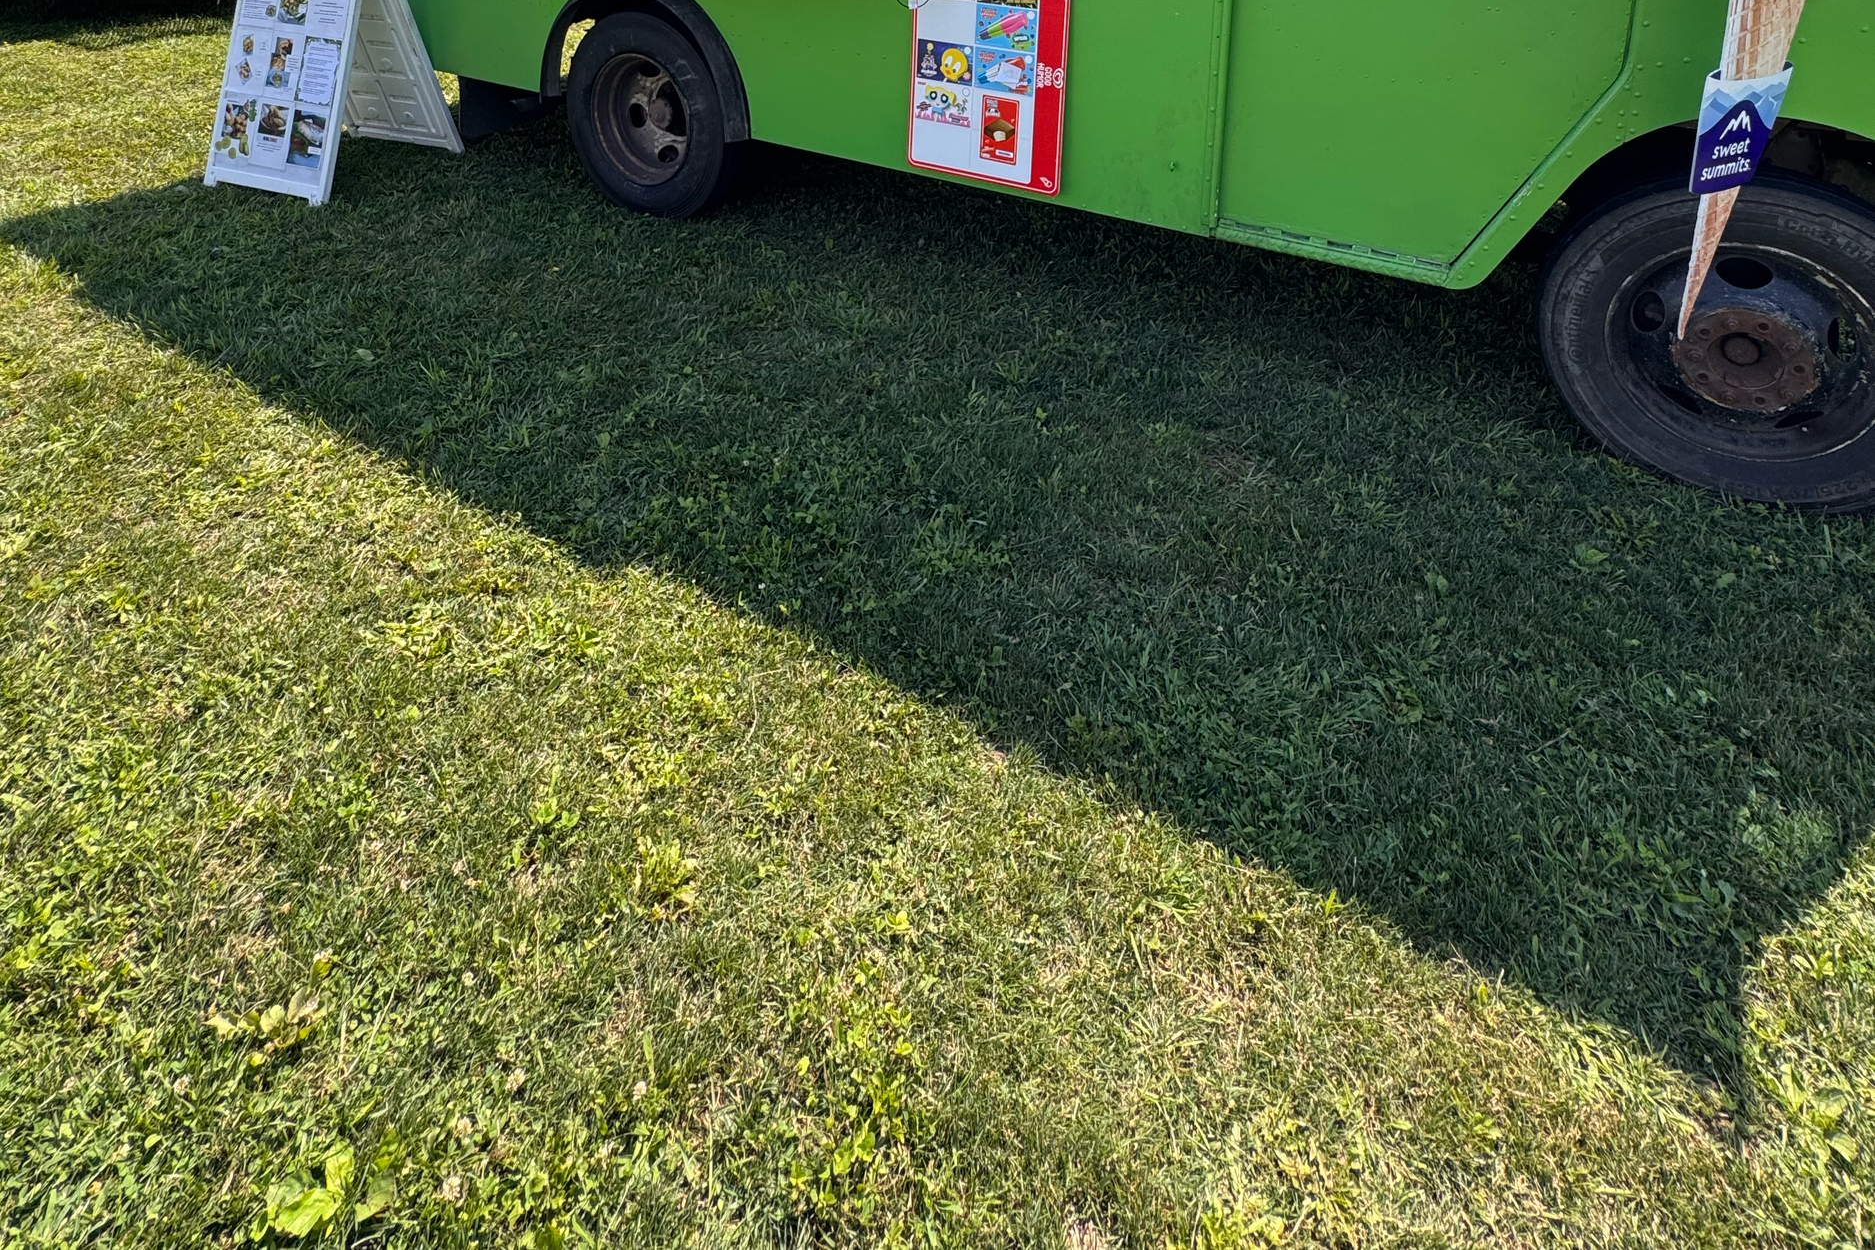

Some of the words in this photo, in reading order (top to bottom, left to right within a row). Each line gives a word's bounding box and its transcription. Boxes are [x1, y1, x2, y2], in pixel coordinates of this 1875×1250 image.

[1036, 62, 1045, 89] HUMOR
[1044, 66, 1053, 88] GOOD
[1711, 137, 1751, 160] sweet
[1700, 156, 1751, 181] summits
